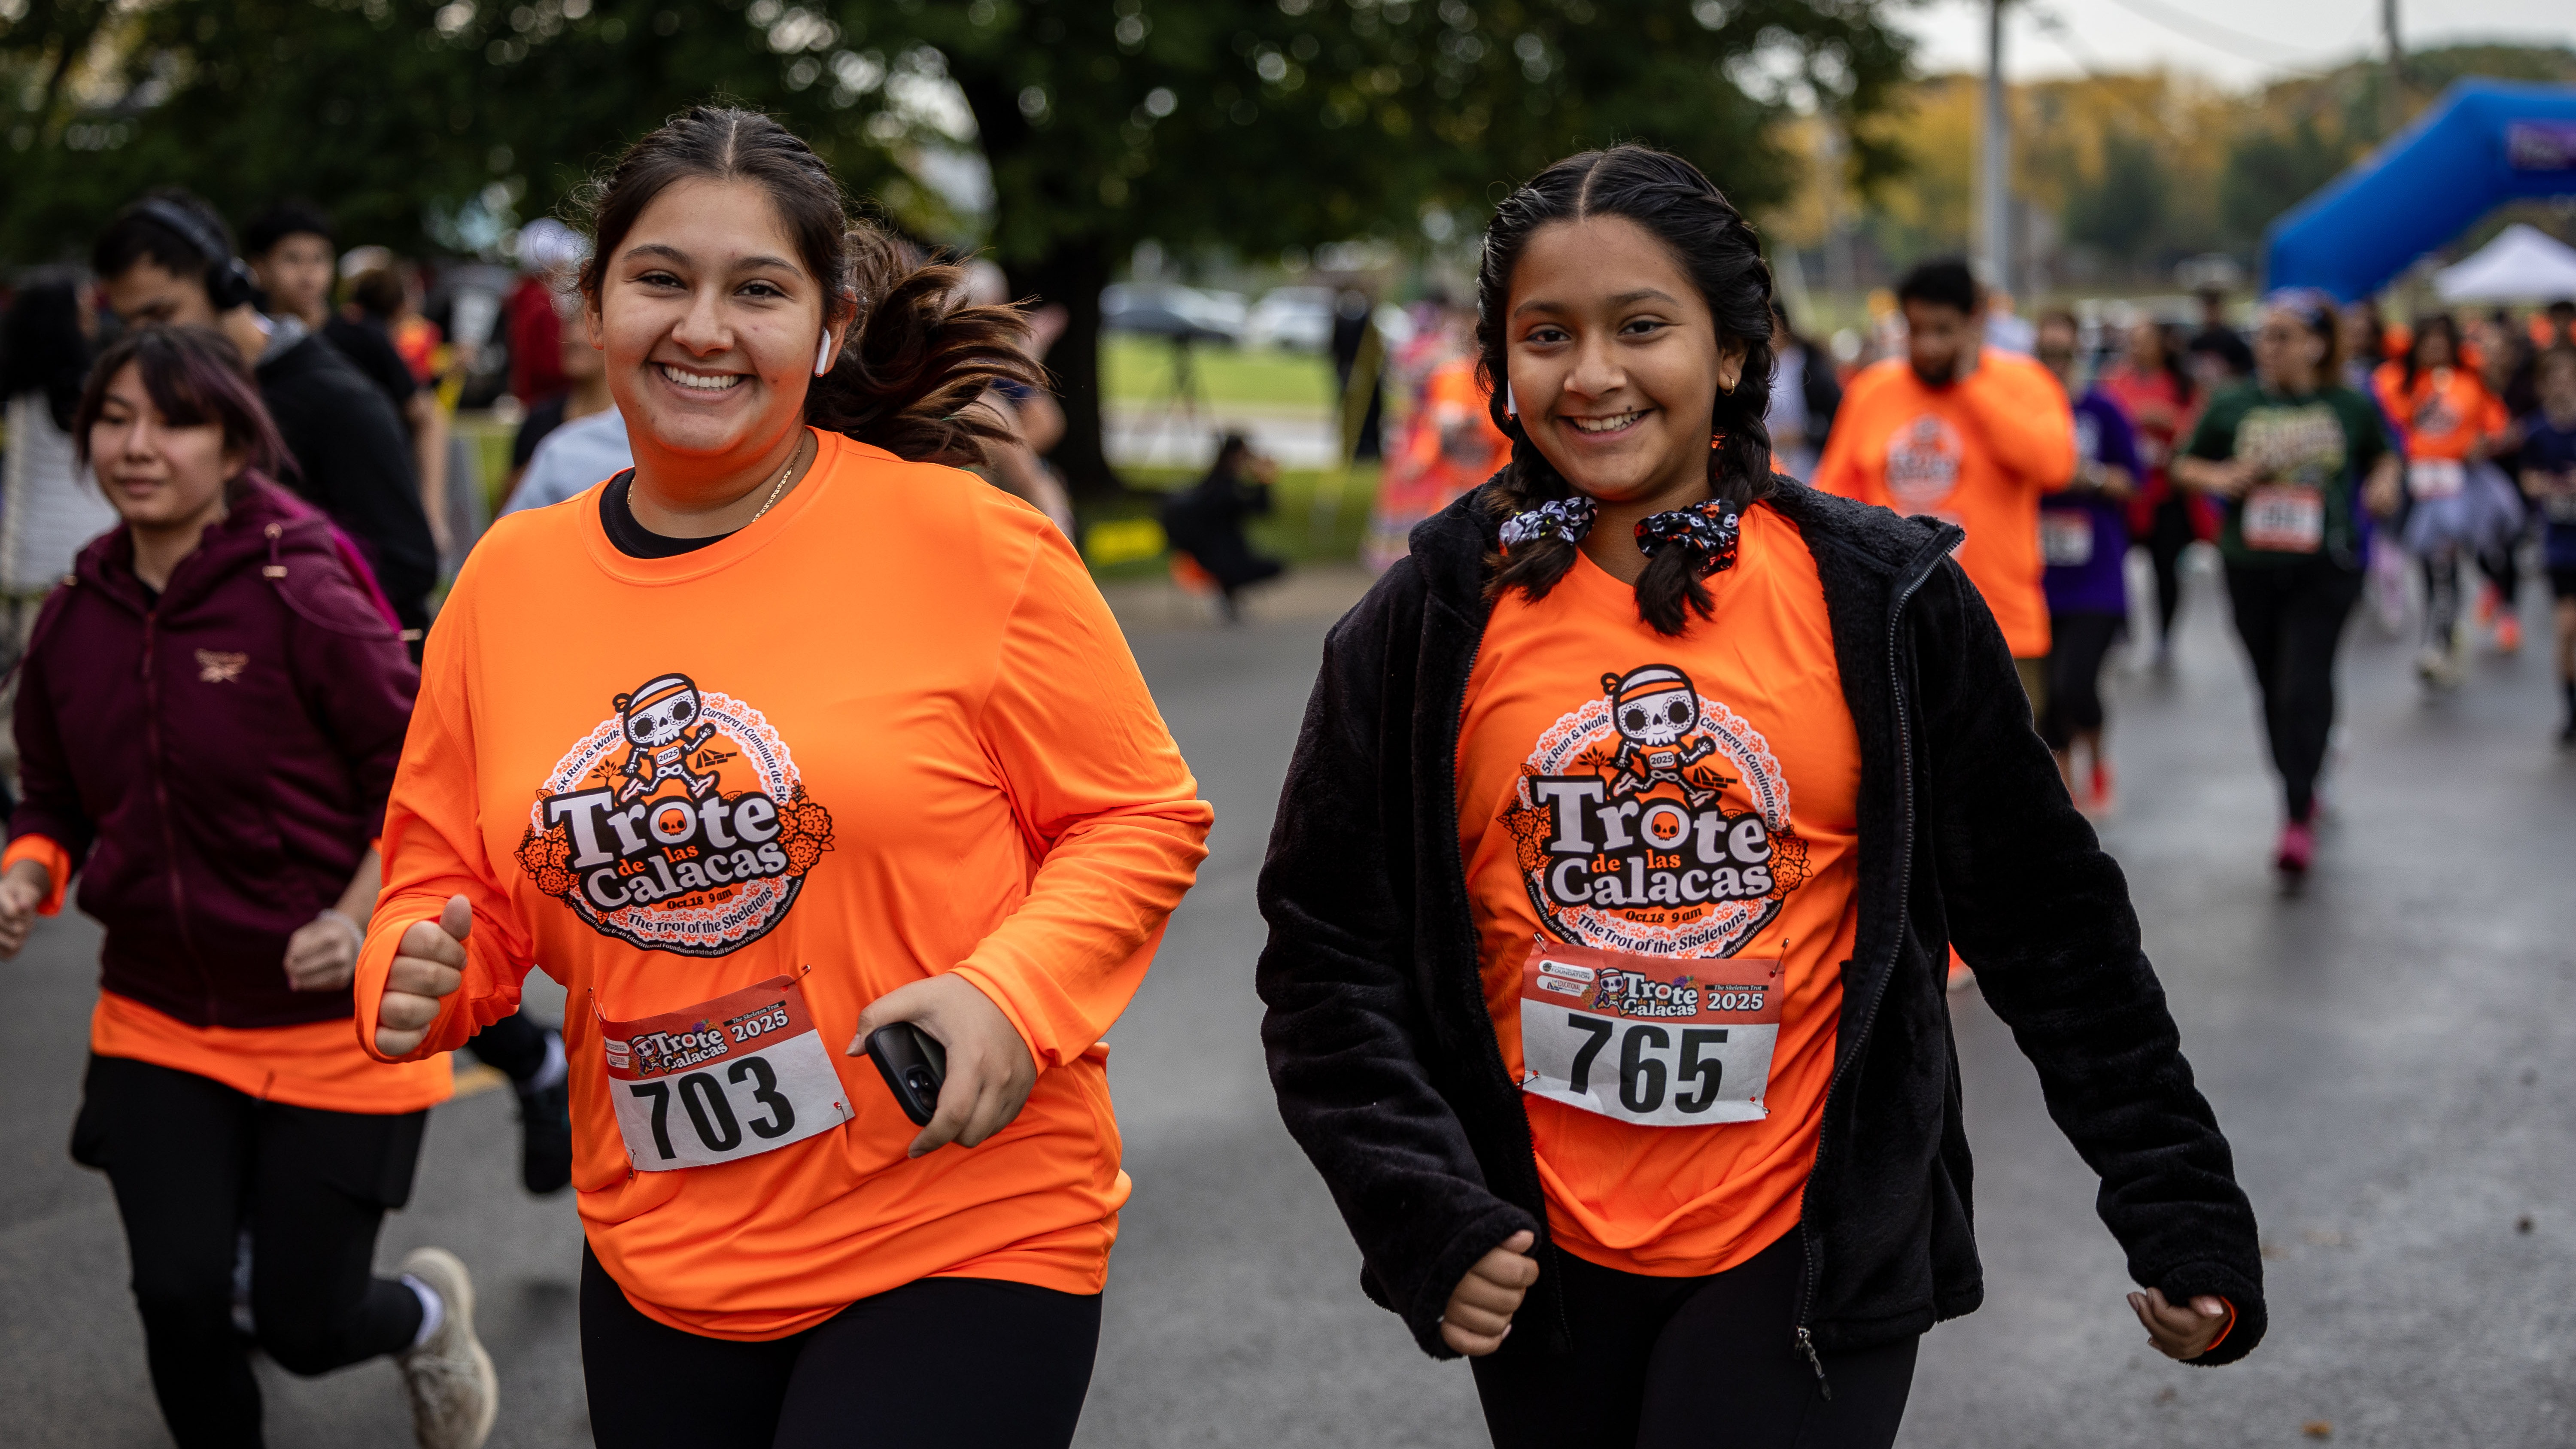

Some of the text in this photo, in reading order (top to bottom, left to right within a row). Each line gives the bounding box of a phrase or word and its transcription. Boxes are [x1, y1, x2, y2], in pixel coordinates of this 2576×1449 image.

[702, 708, 741, 728] Carrera
[658, 749, 678, 762] 2025
[744, 729, 776, 769] Caminata
[1541, 714, 1609, 774] 5K Run & Walk
[1650, 755, 1673, 764] 2025
[556, 729, 620, 793] 5K Run & Walk
[771, 770, 782, 784] de
[1700, 717, 1742, 749] Carrera
[1745, 754, 1774, 807] Caminata
[1767, 810, 1778, 822] de
[775, 786, 787, 802] 5K
[550, 791, 781, 868] Trote
[1536, 781, 1771, 863] Trote
[587, 842, 787, 907] Calacas
[618, 845, 699, 876] de las
[1591, 849, 1681, 873] de las
[709, 893, 715, 903] 9
[717, 889, 733, 901] am
[1552, 857, 1772, 905] Calacas
[629, 887, 773, 933] The Trot of the Skeletons
[1528, 885, 1545, 915] Presented
[1543, 913, 1549, 923] by
[1547, 920, 1557, 929] the
[1555, 925, 1569, 938] U-46
[1671, 912, 1680, 922] 9
[1682, 908, 1702, 921] am
[1735, 929, 1755, 947] District
[1754, 902, 1781, 932] Foundation
[572, 902, 596, 923] Presented
[611, 929, 627, 937] U-46
[626, 935, 662, 948] Educational
[662, 943, 695, 954] Foundation
[725, 939, 746, 952] Borden
[745, 931, 761, 943] Public
[1578, 908, 1747, 953] The Trot of the Skeletons
[1551, 968, 1590, 980] FOUNDATION
[1622, 972, 1698, 1005] Trote
[743, 1009, 767, 1020] Skeleton
[1623, 999, 1697, 1016] Calacas
[1707, 993, 1763, 1010] 2025
[731, 1009, 789, 1042] 2025
[648, 1030, 724, 1055] Trote
[663, 1043, 728, 1069] Calacas
[1567, 1012, 1729, 1114] 765
[629, 1055, 796, 1160] 703
